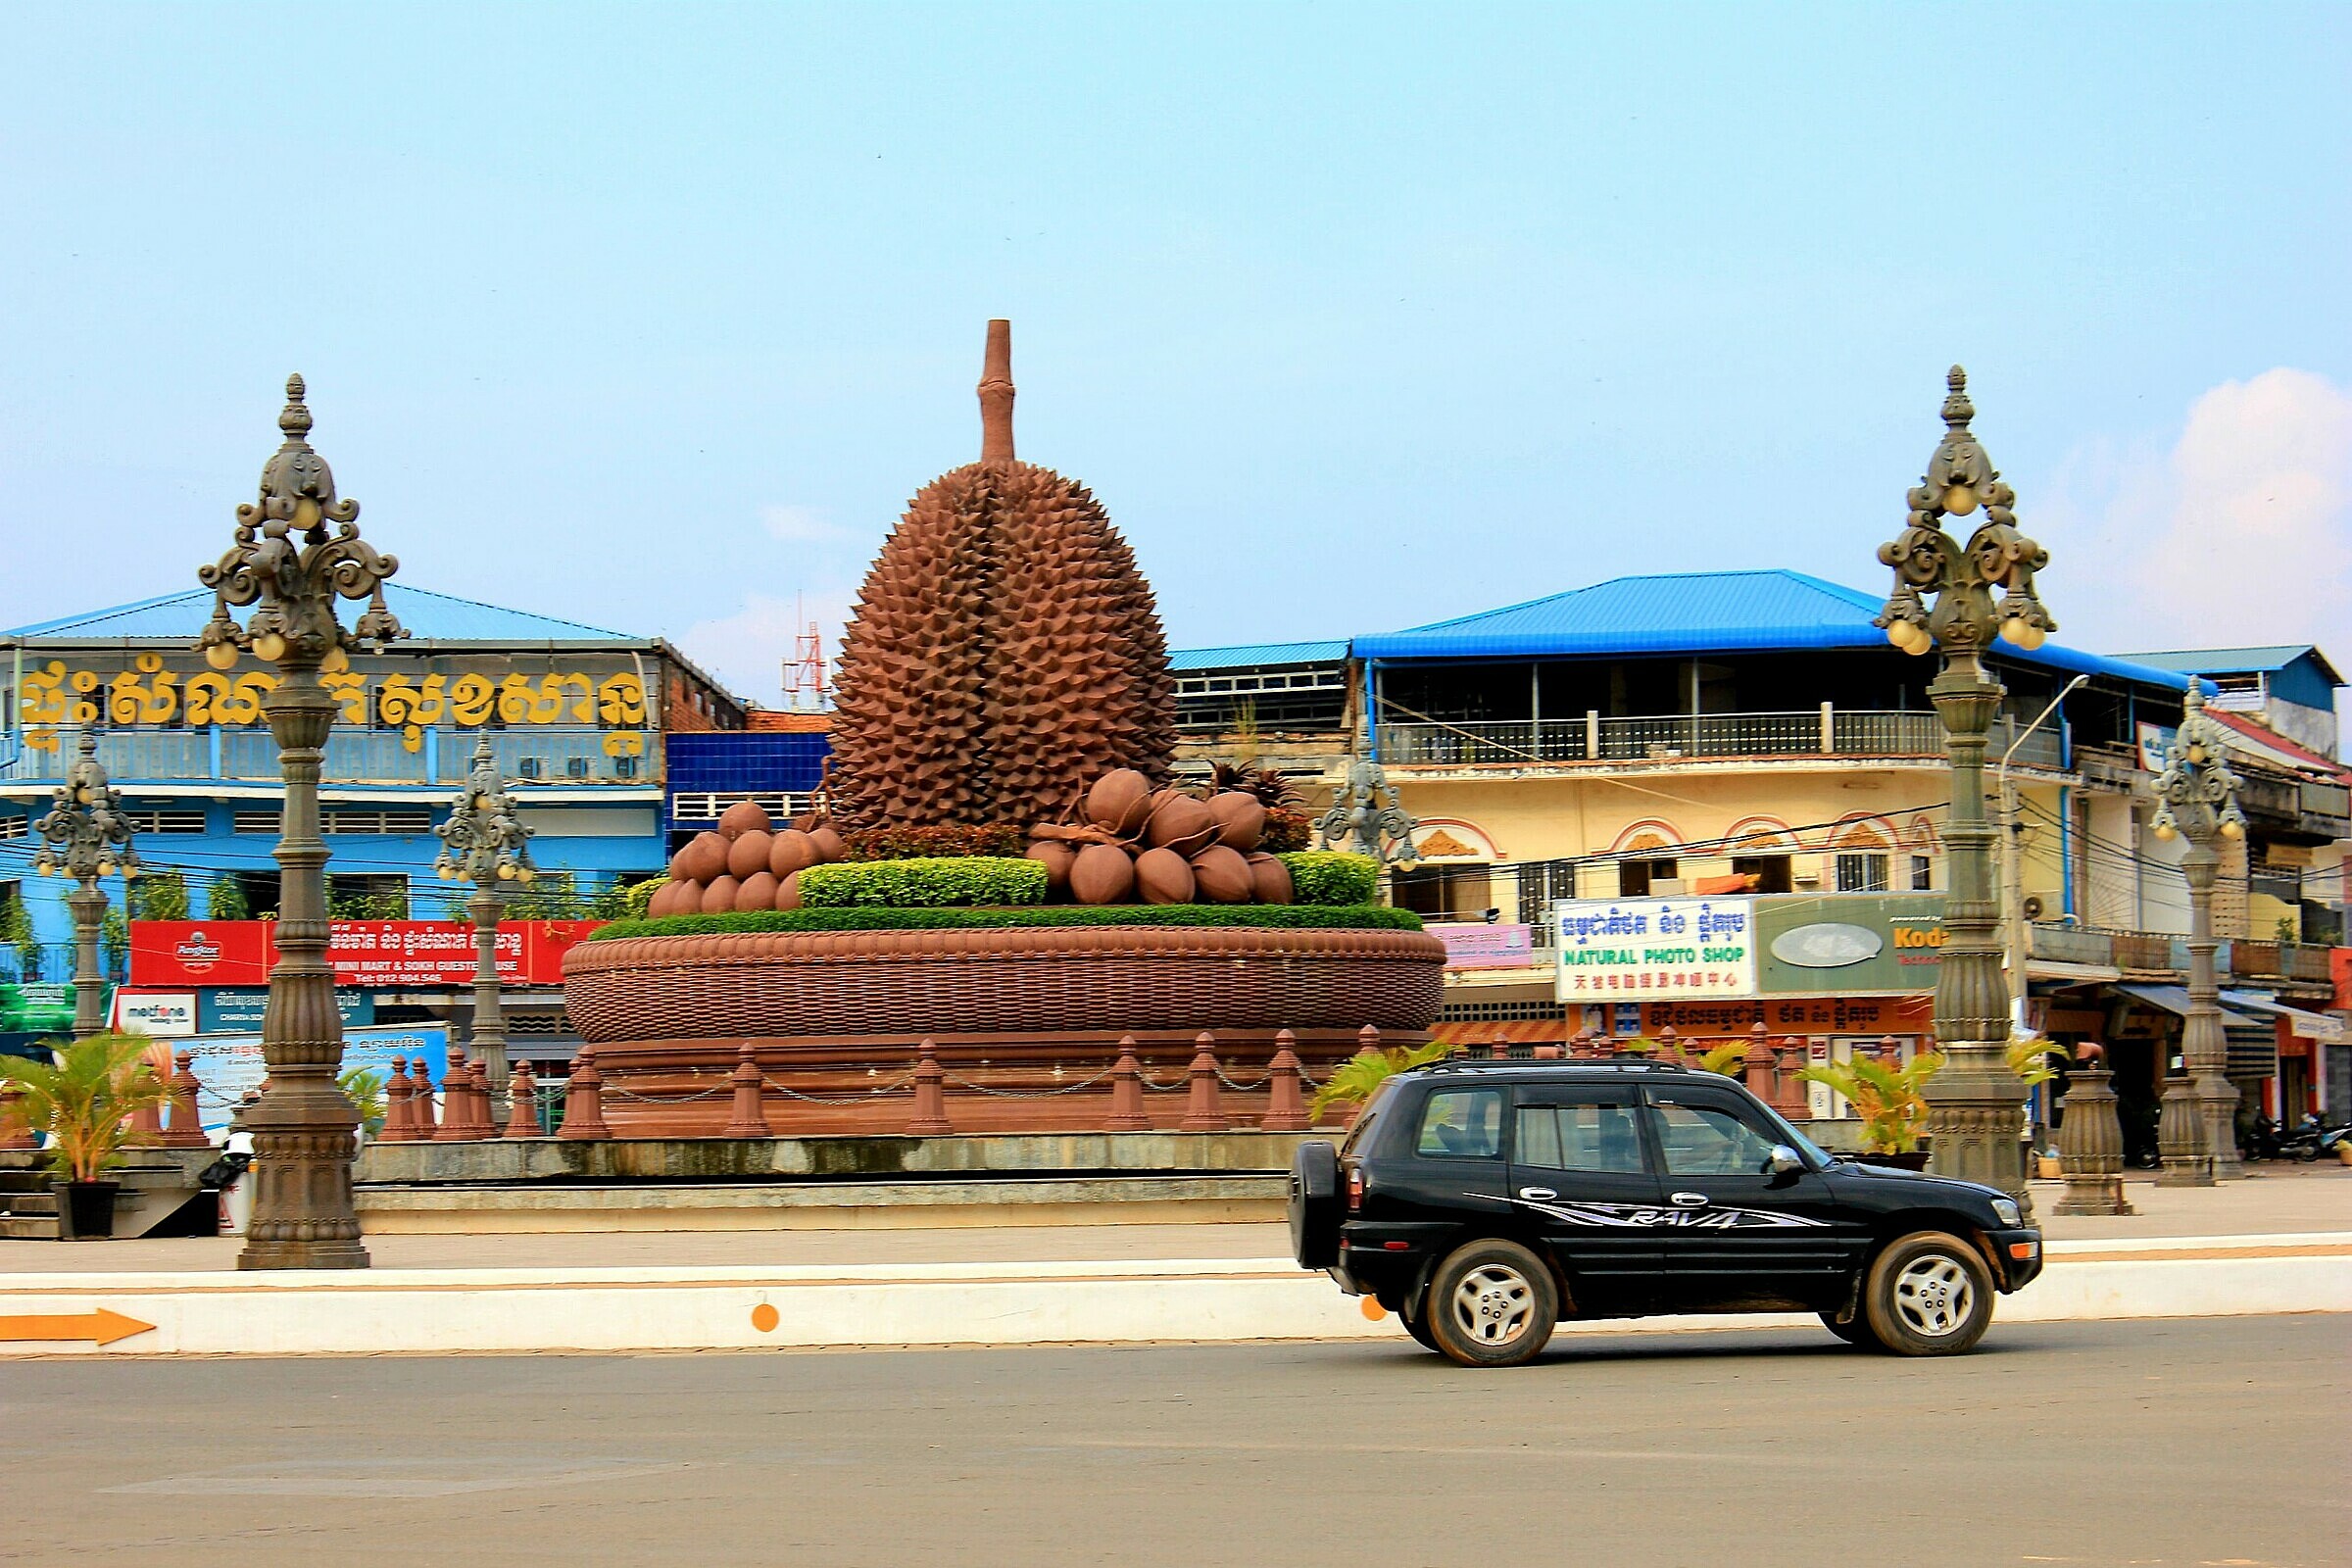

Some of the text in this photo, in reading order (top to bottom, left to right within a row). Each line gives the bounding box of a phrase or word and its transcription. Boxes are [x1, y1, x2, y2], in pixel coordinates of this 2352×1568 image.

[176, 945, 220, 956] Angkor
[1564, 947, 1745, 965] NATURAL PHOTO SHOP
[334, 960, 360, 971] MINI
[361, 960, 392, 971] MART
[393, 960, 403, 971] &
[404, 960, 435, 971] SOKH
[376, 973, 397, 983] 012
[1627, 1210, 1742, 1230] RAV4
